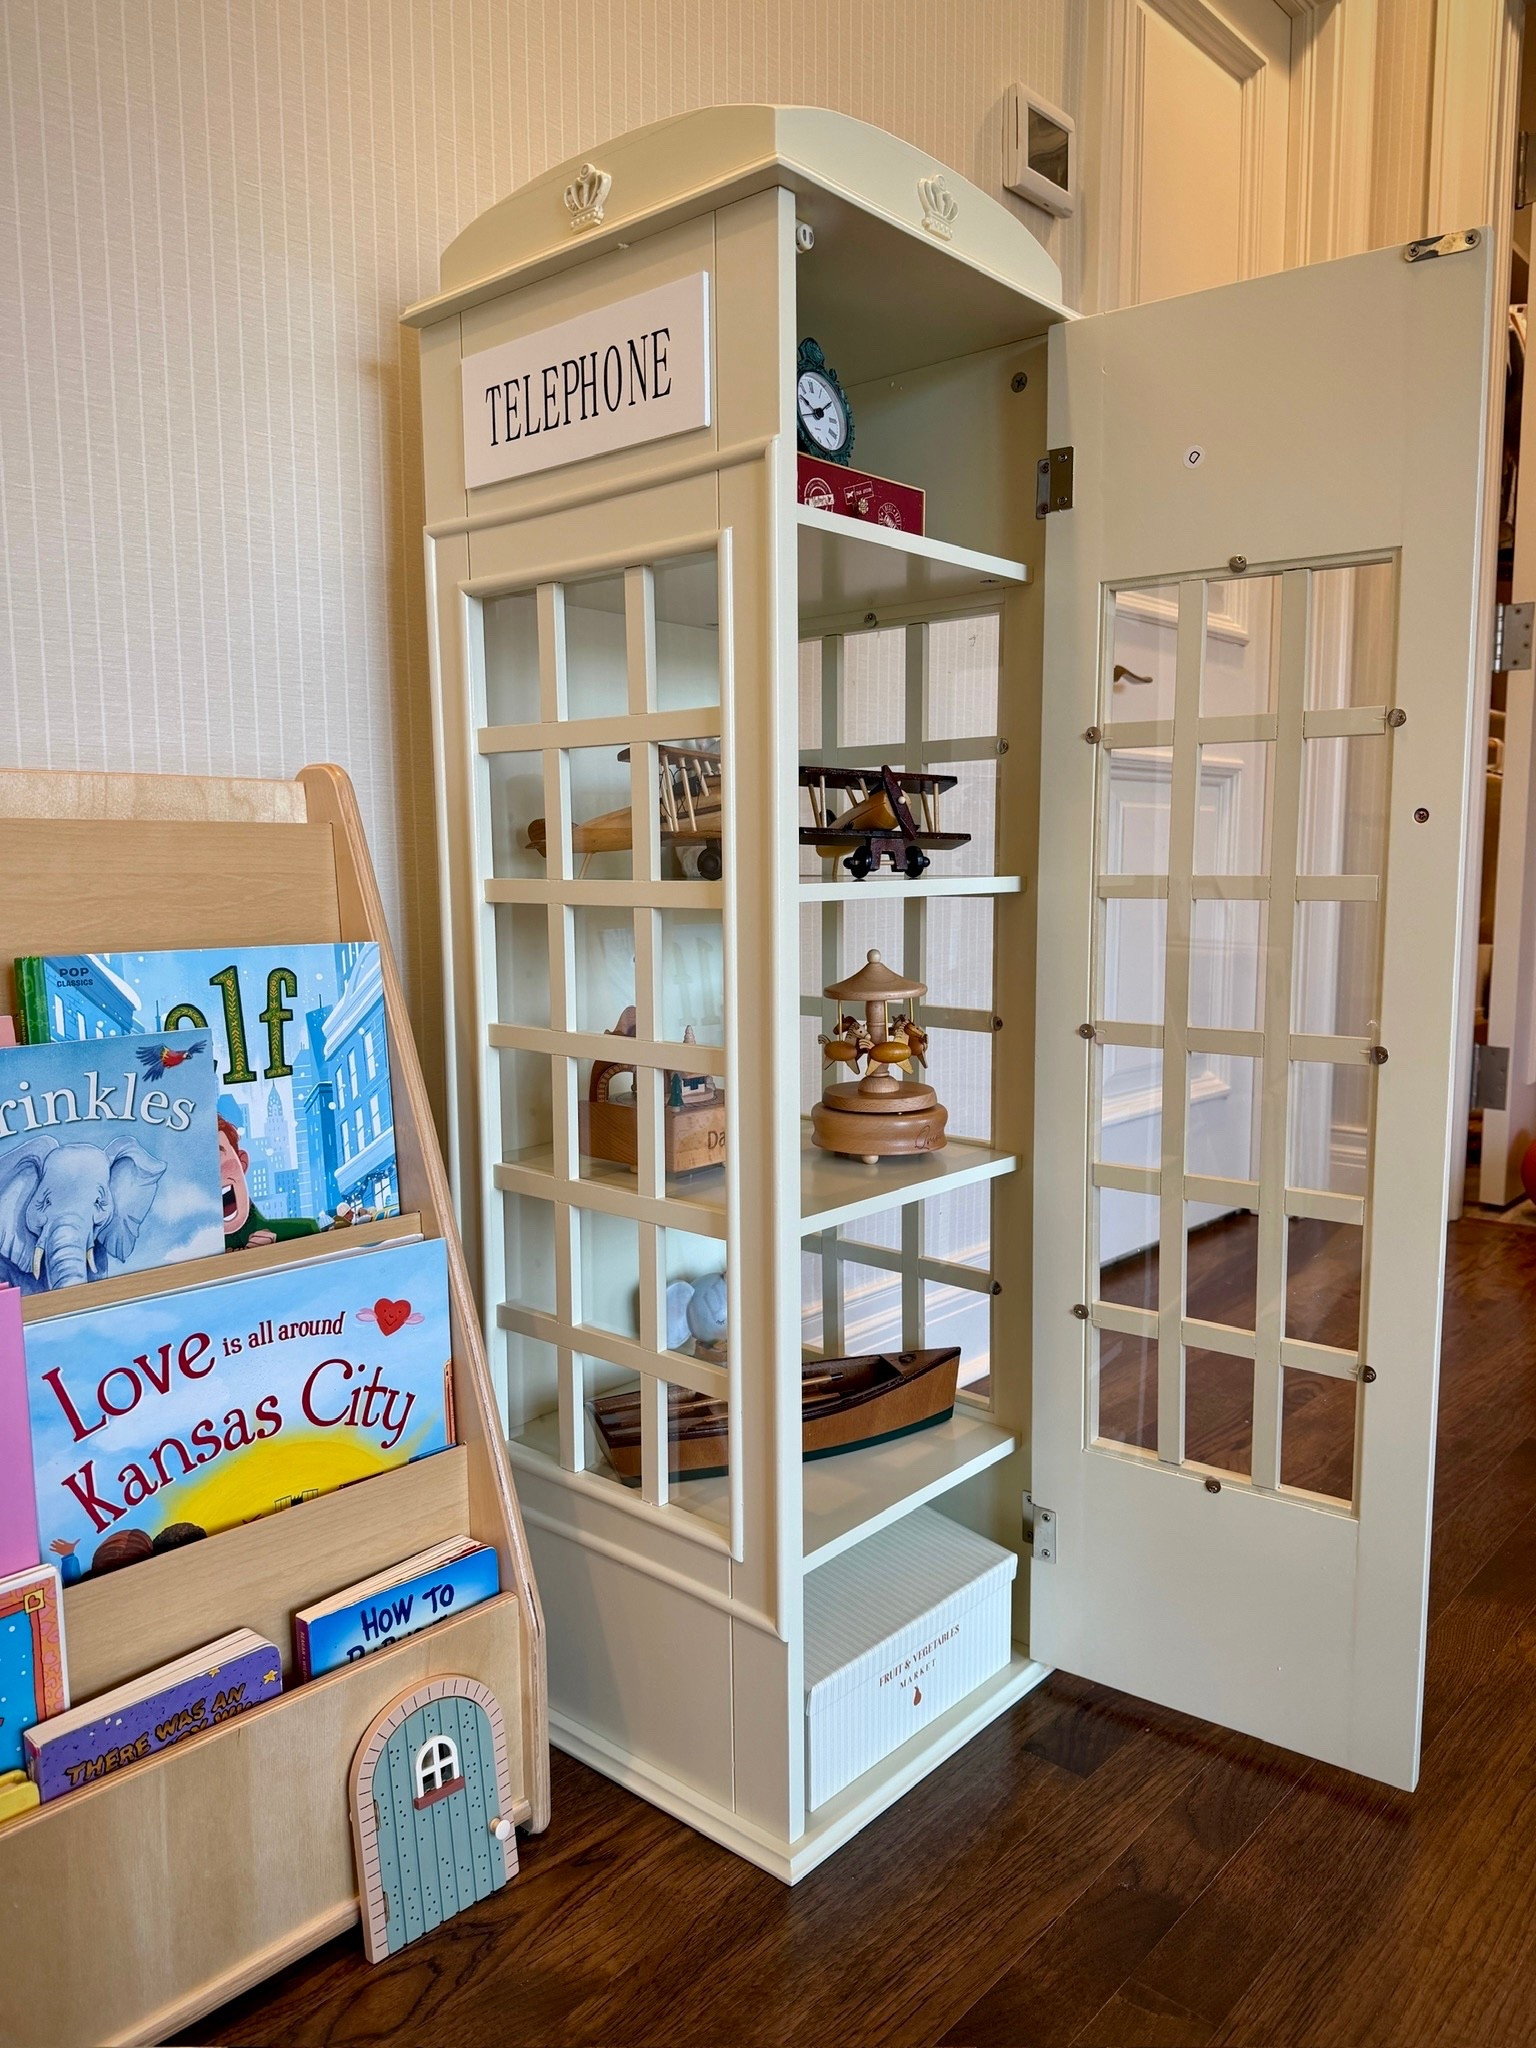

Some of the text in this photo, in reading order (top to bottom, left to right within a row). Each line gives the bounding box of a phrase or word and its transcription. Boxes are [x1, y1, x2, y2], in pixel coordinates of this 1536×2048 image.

[485, 327, 671, 446] TELEPHONE
[56, 979, 94, 988] CLASSICS
[59, 967, 90, 977] POP
[0, 1071, 196, 1138] rinkles
[42, 1311, 346, 1443] Love is all around
[61, 1358, 417, 1534] Kansas City
[361, 1594, 414, 1641] HOW
[422, 1584, 455, 1614] TO
[879, 1624, 960, 1687] FRUIT & VEGETABLES
[900, 1658, 936, 1689] MARKET
[64, 1732, 152, 1786] THERE
[154, 1697, 207, 1742] WAS
[211, 1682, 247, 1714] AN
